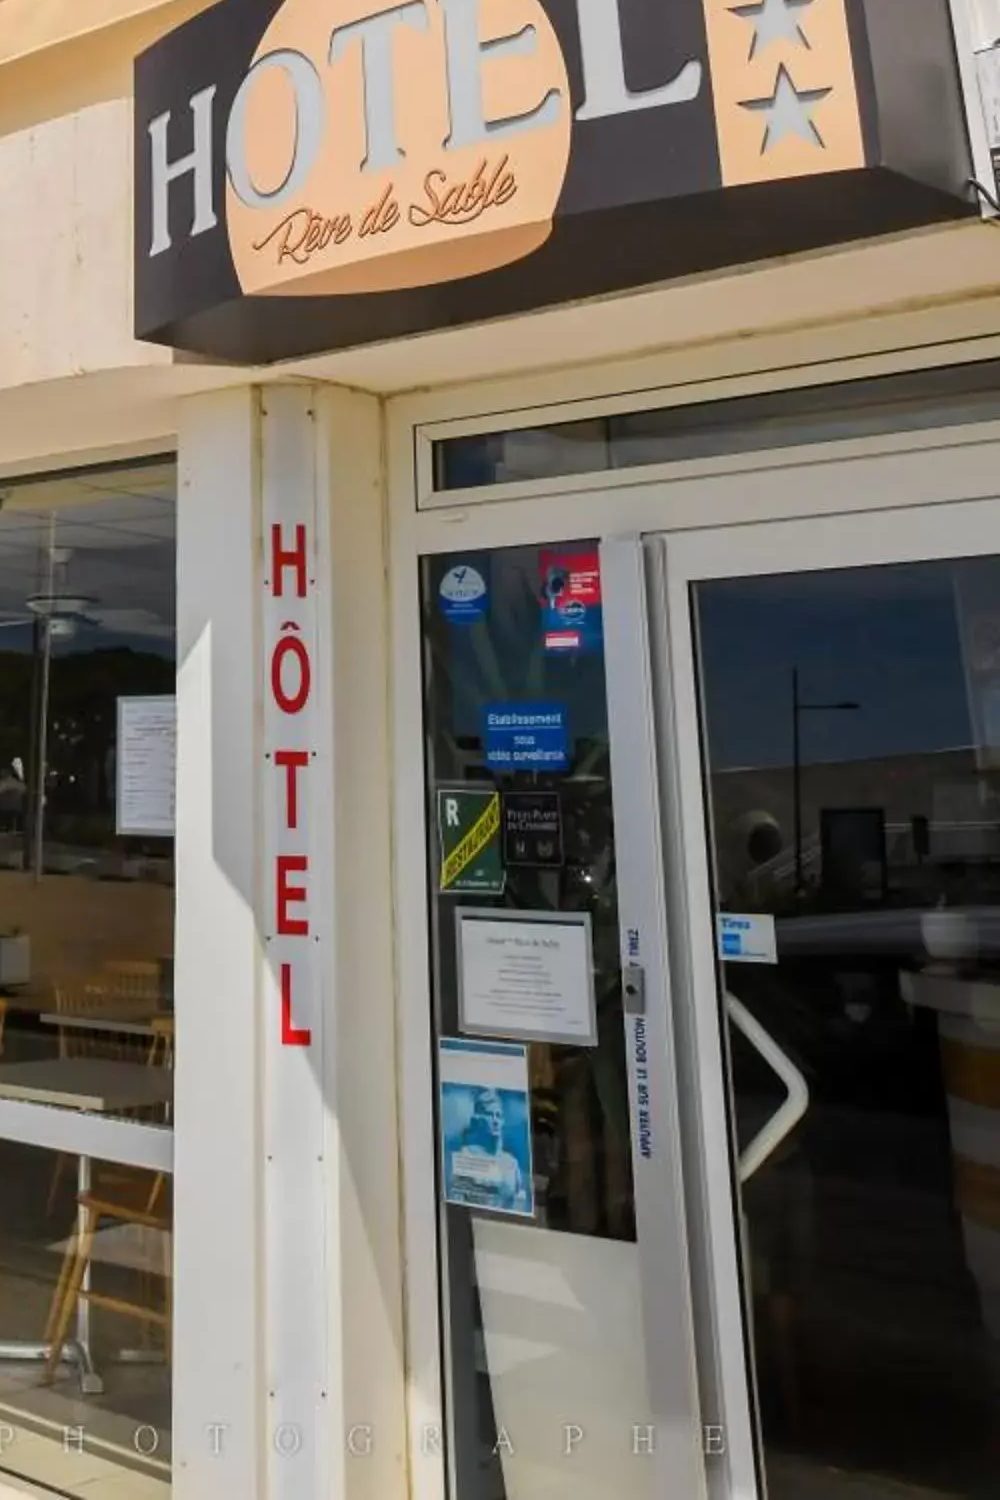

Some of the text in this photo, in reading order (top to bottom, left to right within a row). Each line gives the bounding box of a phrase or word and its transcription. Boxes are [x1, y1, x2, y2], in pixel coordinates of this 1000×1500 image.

[252, 154, 518, 265] Rêve de Sable
[271, 523, 311, 1047] HÔTEL
[634, 1017, 647, 1063] BOUTON
[637, 1083, 650, 1105] SUR
